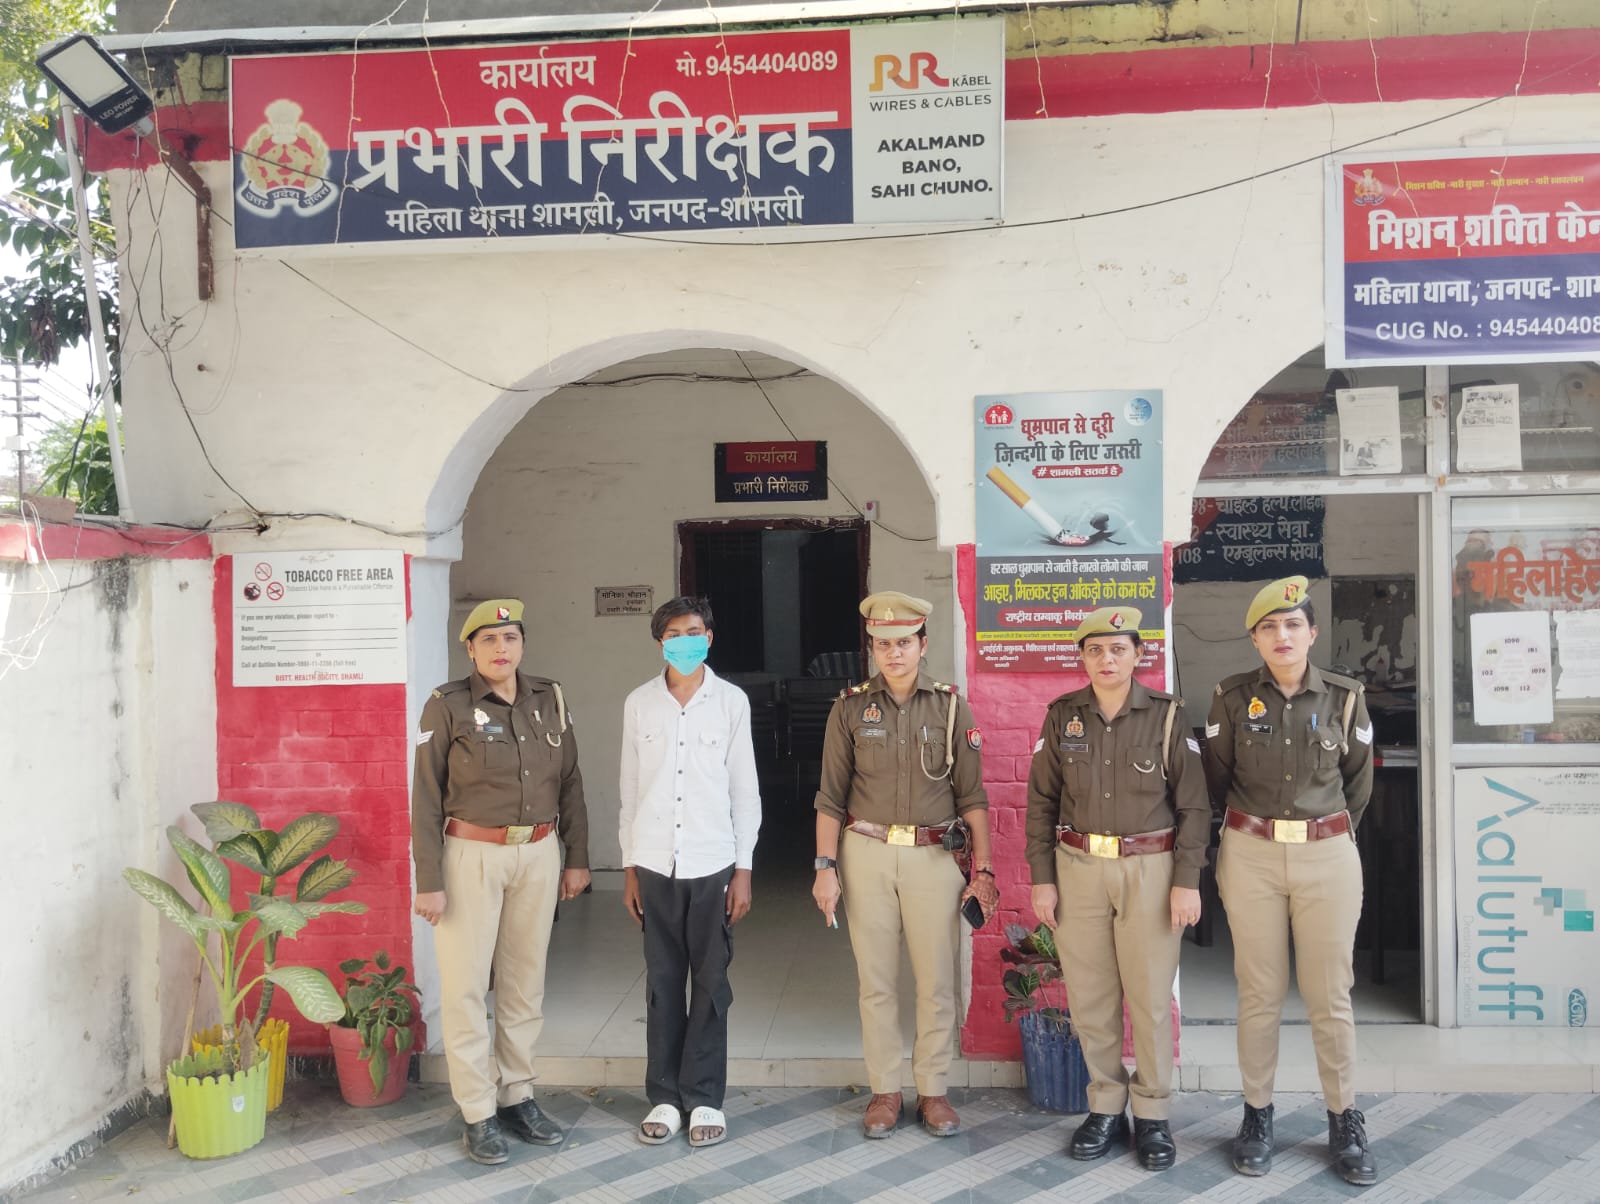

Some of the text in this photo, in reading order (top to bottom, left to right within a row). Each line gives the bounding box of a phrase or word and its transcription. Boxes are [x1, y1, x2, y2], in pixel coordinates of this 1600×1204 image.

[480, 47, 596, 89] कार्यालय
[676, 51, 838, 76] मो. 9454404089
[870, 94, 992, 112] WIRES & CABLES
[353, 90, 839, 194] प्रभारी निरीक्षक
[877, 133, 985, 153] AKALMAND
[902, 158, 961, 176] BANO,
[871, 178, 994, 199] SAHI CHUNO.
[386, 200, 461, 233] महिला
[470, 203, 525, 233] थाना
[533, 192, 624, 230] शामली,
[1368, 209, 1459, 251] मिशन
[1464, 203, 1550, 247] शक्ति
[1354, 277, 1420, 306] महिला
[1424, 280, 1479, 307] थाना,
[1376, 321, 1426, 341] CUG
[1433, 320, 1469, 339] No.
[1074, 413, 1087, 433] से
[1091, 412, 1115, 439] दूरी
[744, 447, 797, 464] कार्यालय
[1050, 440, 1066, 461] के
[1068, 439, 1100, 461] लिए
[1037, 467, 1047, 477] #
[733, 477, 809, 495] प्रभारी निरीक्षक
[1176, 547, 1202, 565] 108
[285, 568, 393, 583] TOBACCO FREE AREA
[1467, 546, 1563, 604] महिला
[984, 583, 1013, 605] आइए,
[1014, 578, 1051, 601] मिलकर
[1051, 583, 1067, 604] इन
[1102, 577, 1117, 600] को
[1118, 581, 1137, 600] कम
[1476, 776, 1544, 1021] Valutuff
